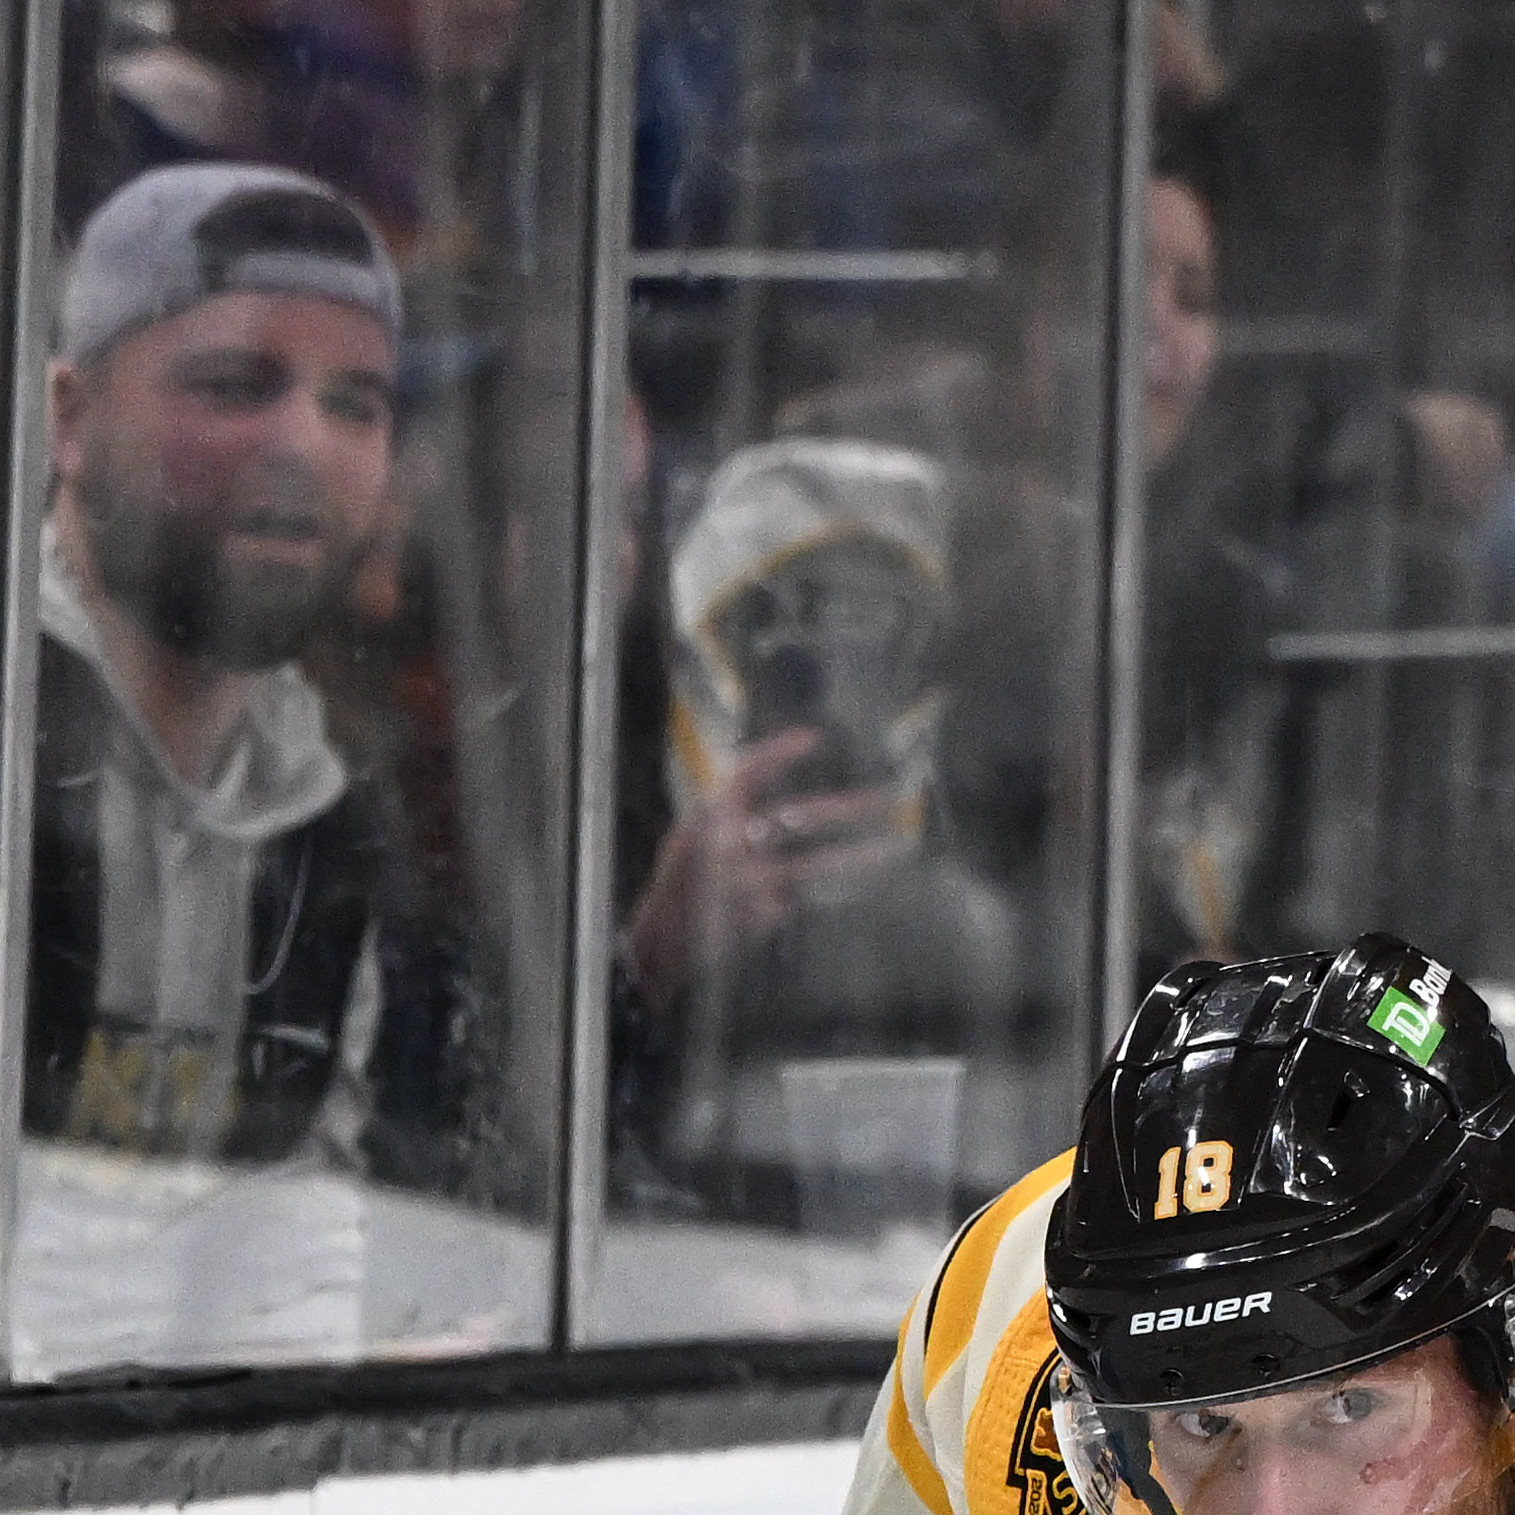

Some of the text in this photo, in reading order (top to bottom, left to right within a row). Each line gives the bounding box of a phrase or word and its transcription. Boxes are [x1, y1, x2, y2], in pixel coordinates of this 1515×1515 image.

[1382, 1001, 1431, 1047] TD
[1153, 1140, 1234, 1219] 18
[1129, 1291, 1272, 1336] BAUER
